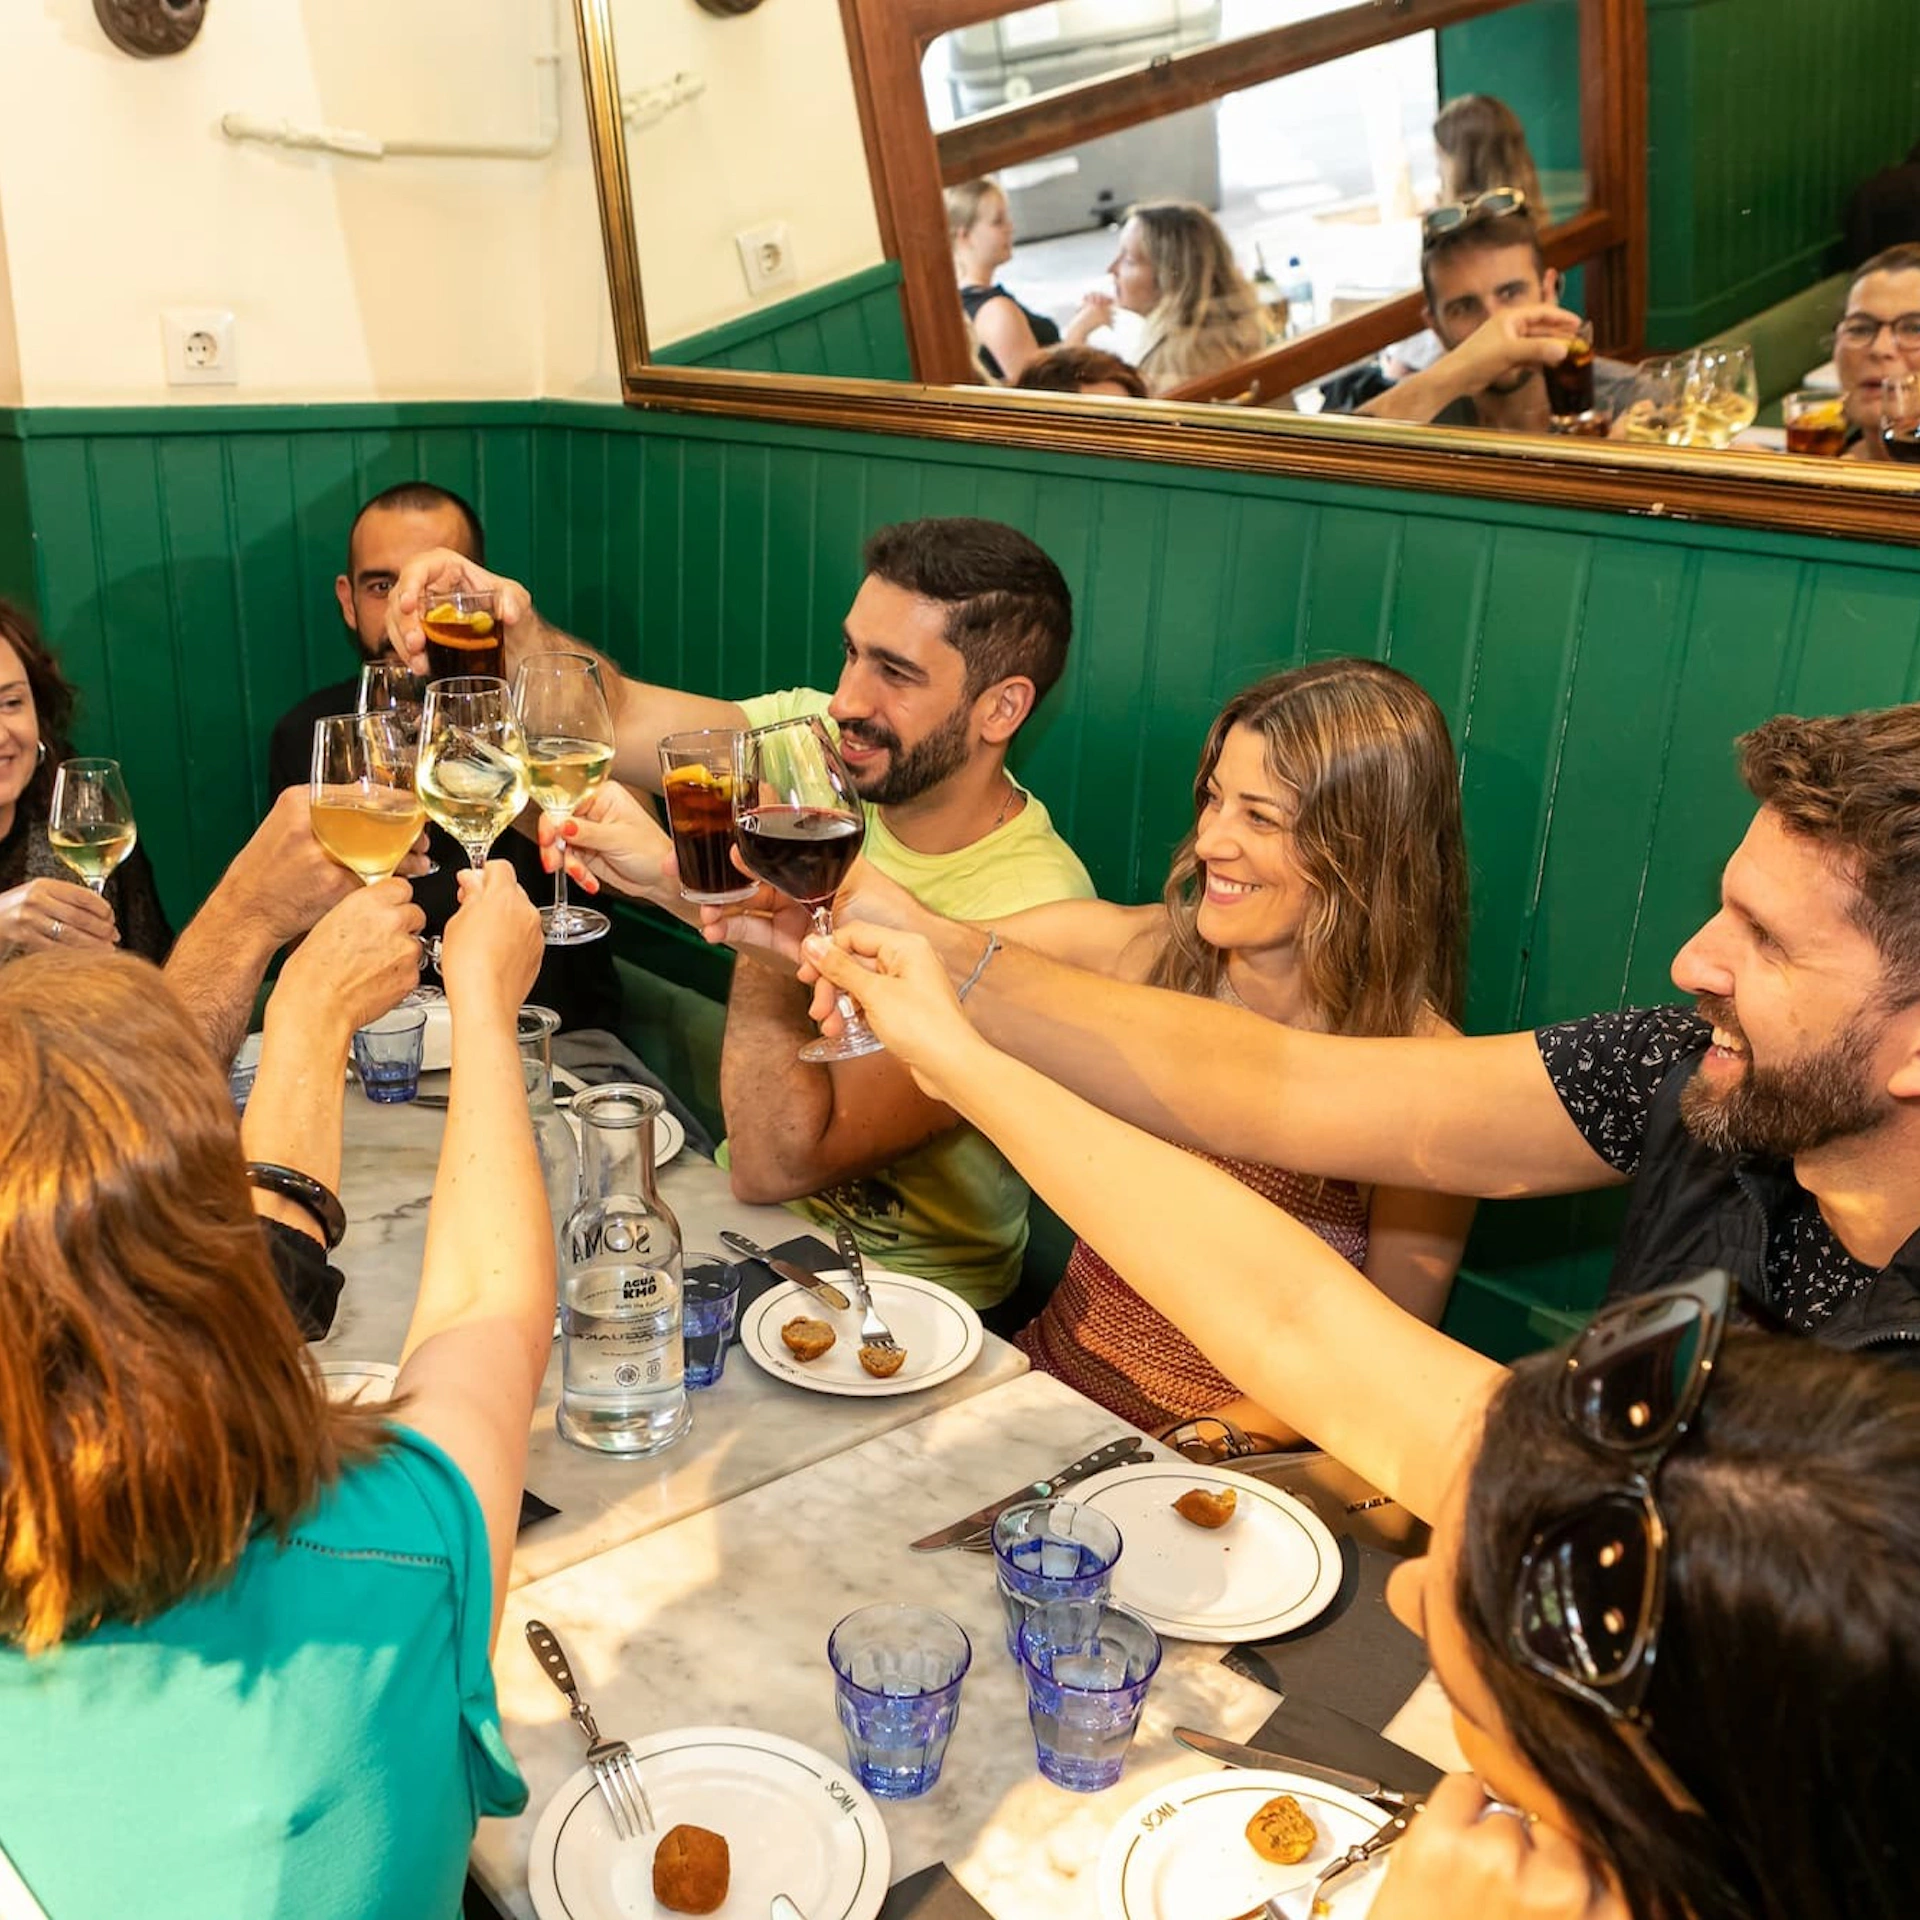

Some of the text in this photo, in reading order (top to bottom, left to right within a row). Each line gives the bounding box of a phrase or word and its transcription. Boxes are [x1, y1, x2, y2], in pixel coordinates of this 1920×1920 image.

[623, 1276, 656, 1288] AGUA
[825, 1781, 858, 1814] SOMA
[1141, 1802, 1178, 1831] SOMA
